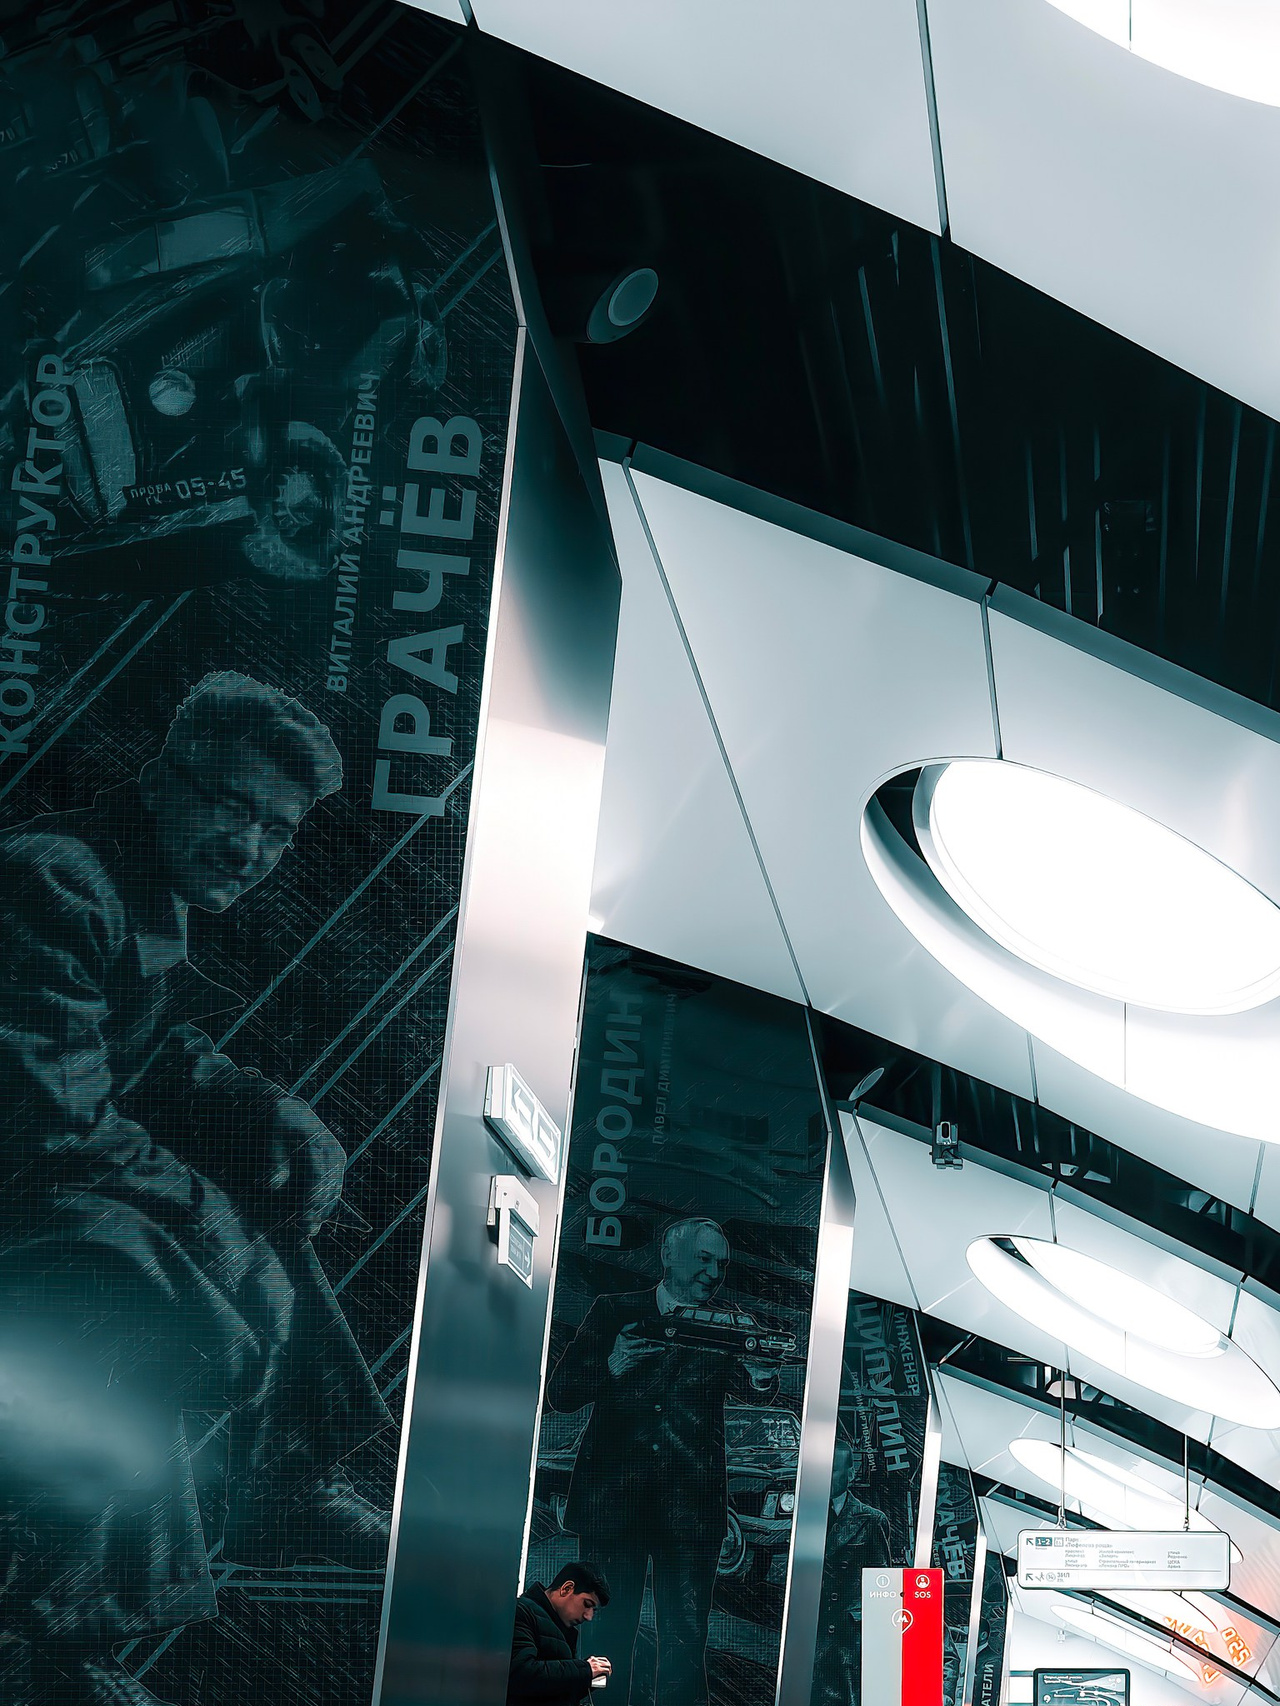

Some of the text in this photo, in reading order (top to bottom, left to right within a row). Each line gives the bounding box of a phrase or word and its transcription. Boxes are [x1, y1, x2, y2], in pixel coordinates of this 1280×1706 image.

[0, 353, 75, 755] КОНСТРУКТОР
[326, 372, 381, 692] ВИТАЛИЙ АНДРЕЕВИЧ
[371, 415, 484, 817] ГРАЧЁВ
[586, 991, 645, 1247] БОРОДИН
[651, 1096, 667, 1145] ПАВЕЛ
[852, 1301, 911, 1473] ЦИПУЛИН
[894, 1311, 920, 1396] ИНЖЕНЕР
[869, 1590, 897, 1598] ИНФО
[913, 1590, 932, 1599] SOS
